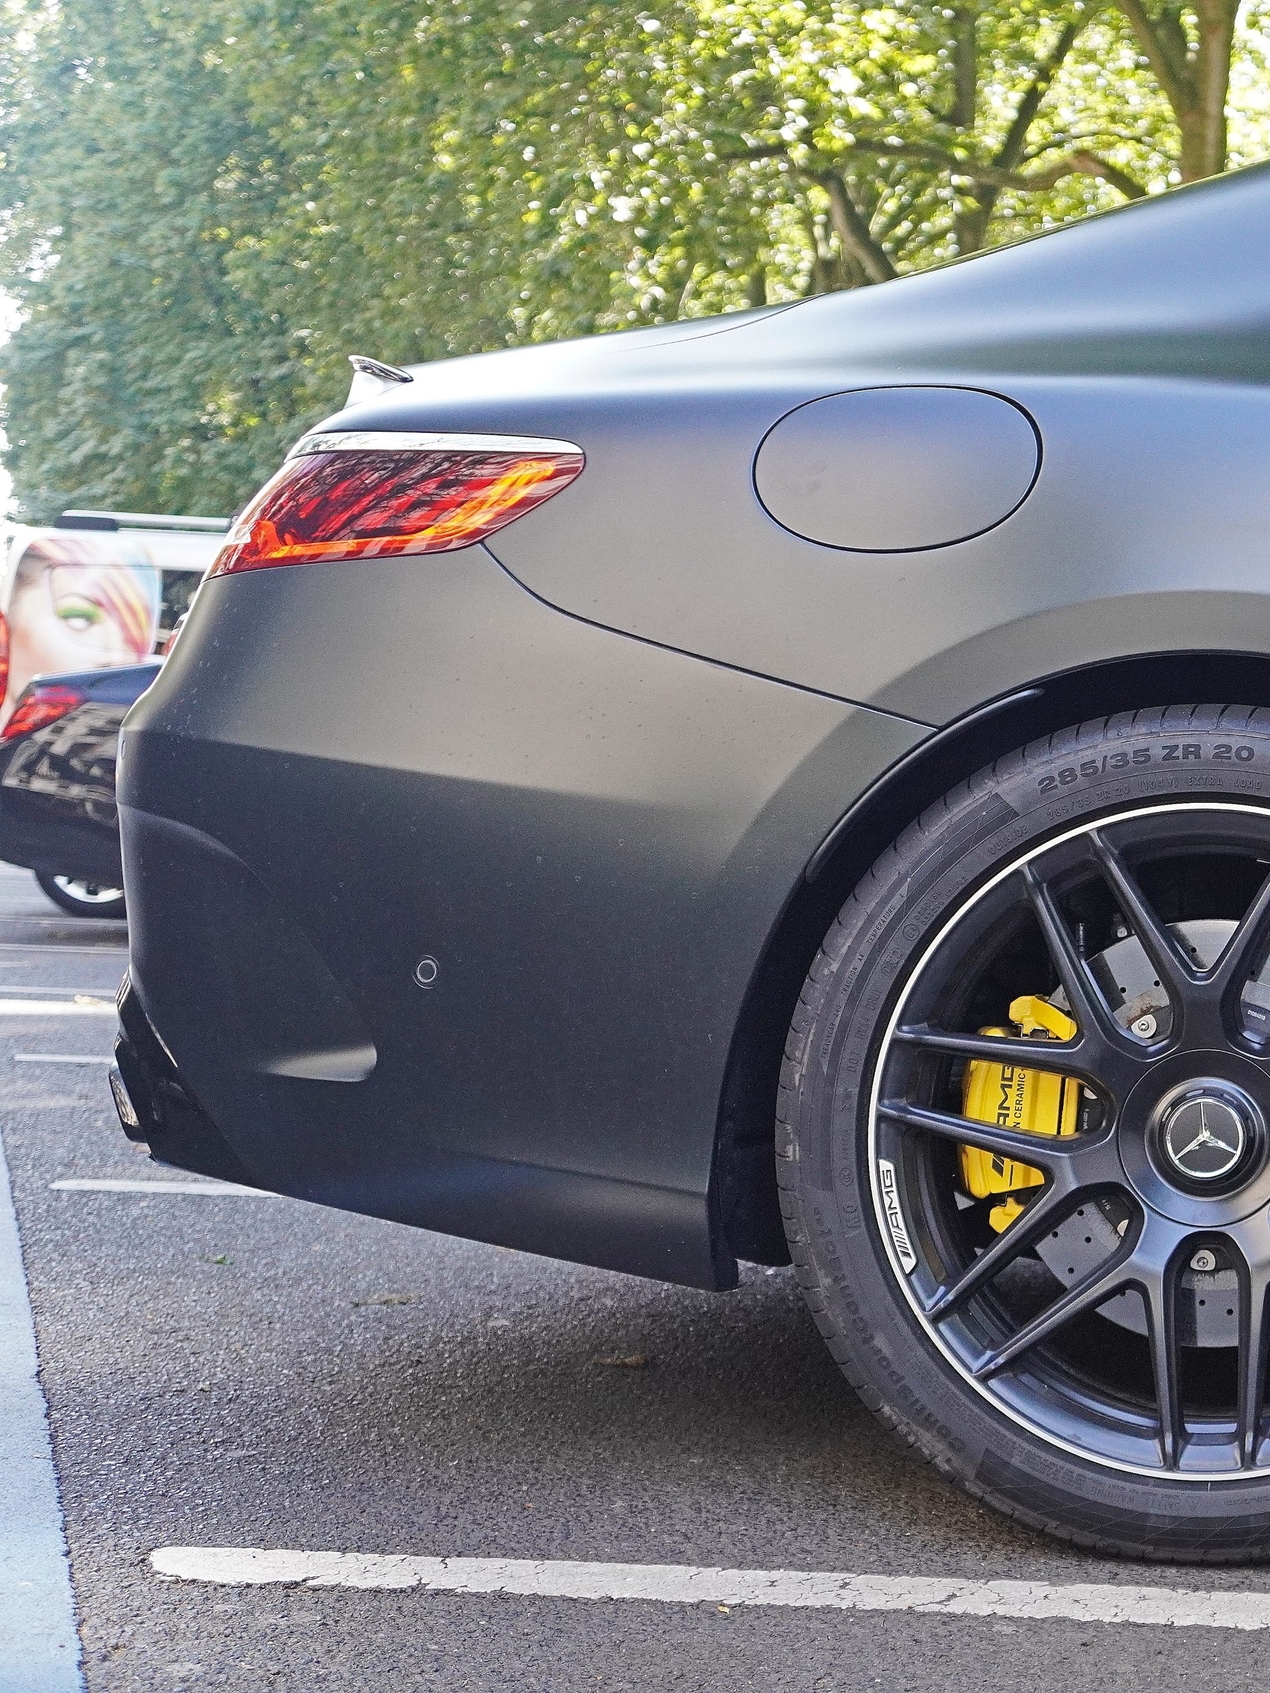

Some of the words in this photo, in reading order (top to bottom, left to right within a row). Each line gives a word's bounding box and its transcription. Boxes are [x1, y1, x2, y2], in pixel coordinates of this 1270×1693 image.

[1037, 747, 1152, 795] 285/35
[1161, 743, 1202, 762] ZR
[1212, 743, 1255, 762] 20
[997, 1065, 1014, 1125] AMG
[1013, 1072, 1026, 1119] CERAMIC
[881, 1169, 903, 1230] AMG
